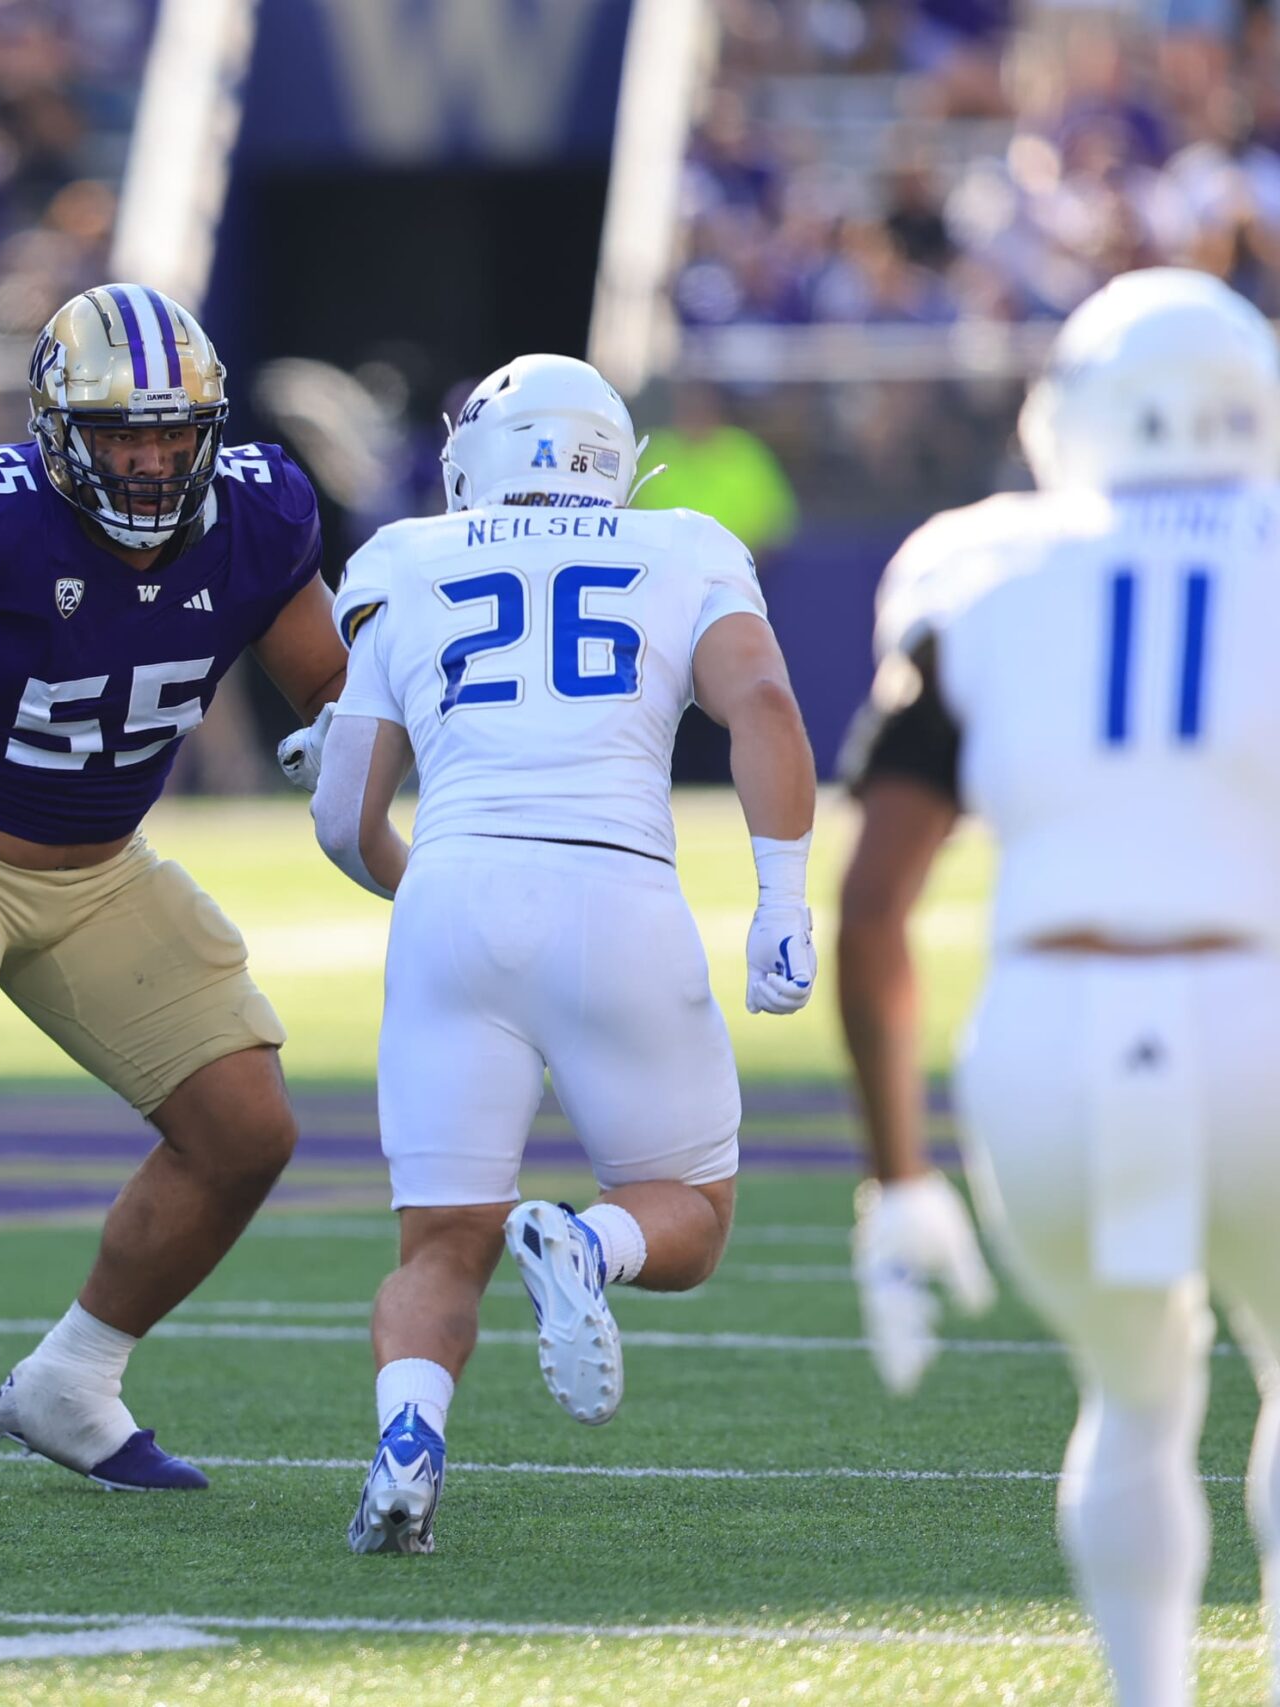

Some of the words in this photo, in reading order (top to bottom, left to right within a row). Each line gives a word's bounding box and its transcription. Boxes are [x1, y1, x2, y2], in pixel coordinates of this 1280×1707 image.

[320, 0, 600, 165] W
[570, 454, 588, 473] 26
[467, 516, 618, 547] NEILSEN
[57, 580, 83, 603] PAC
[61, 595, 76, 610] 12
[137, 585, 161, 602] W
[434, 561, 646, 722] 26
[1103, 567, 1211, 745] 11
[5, 656, 215, 770] 55
